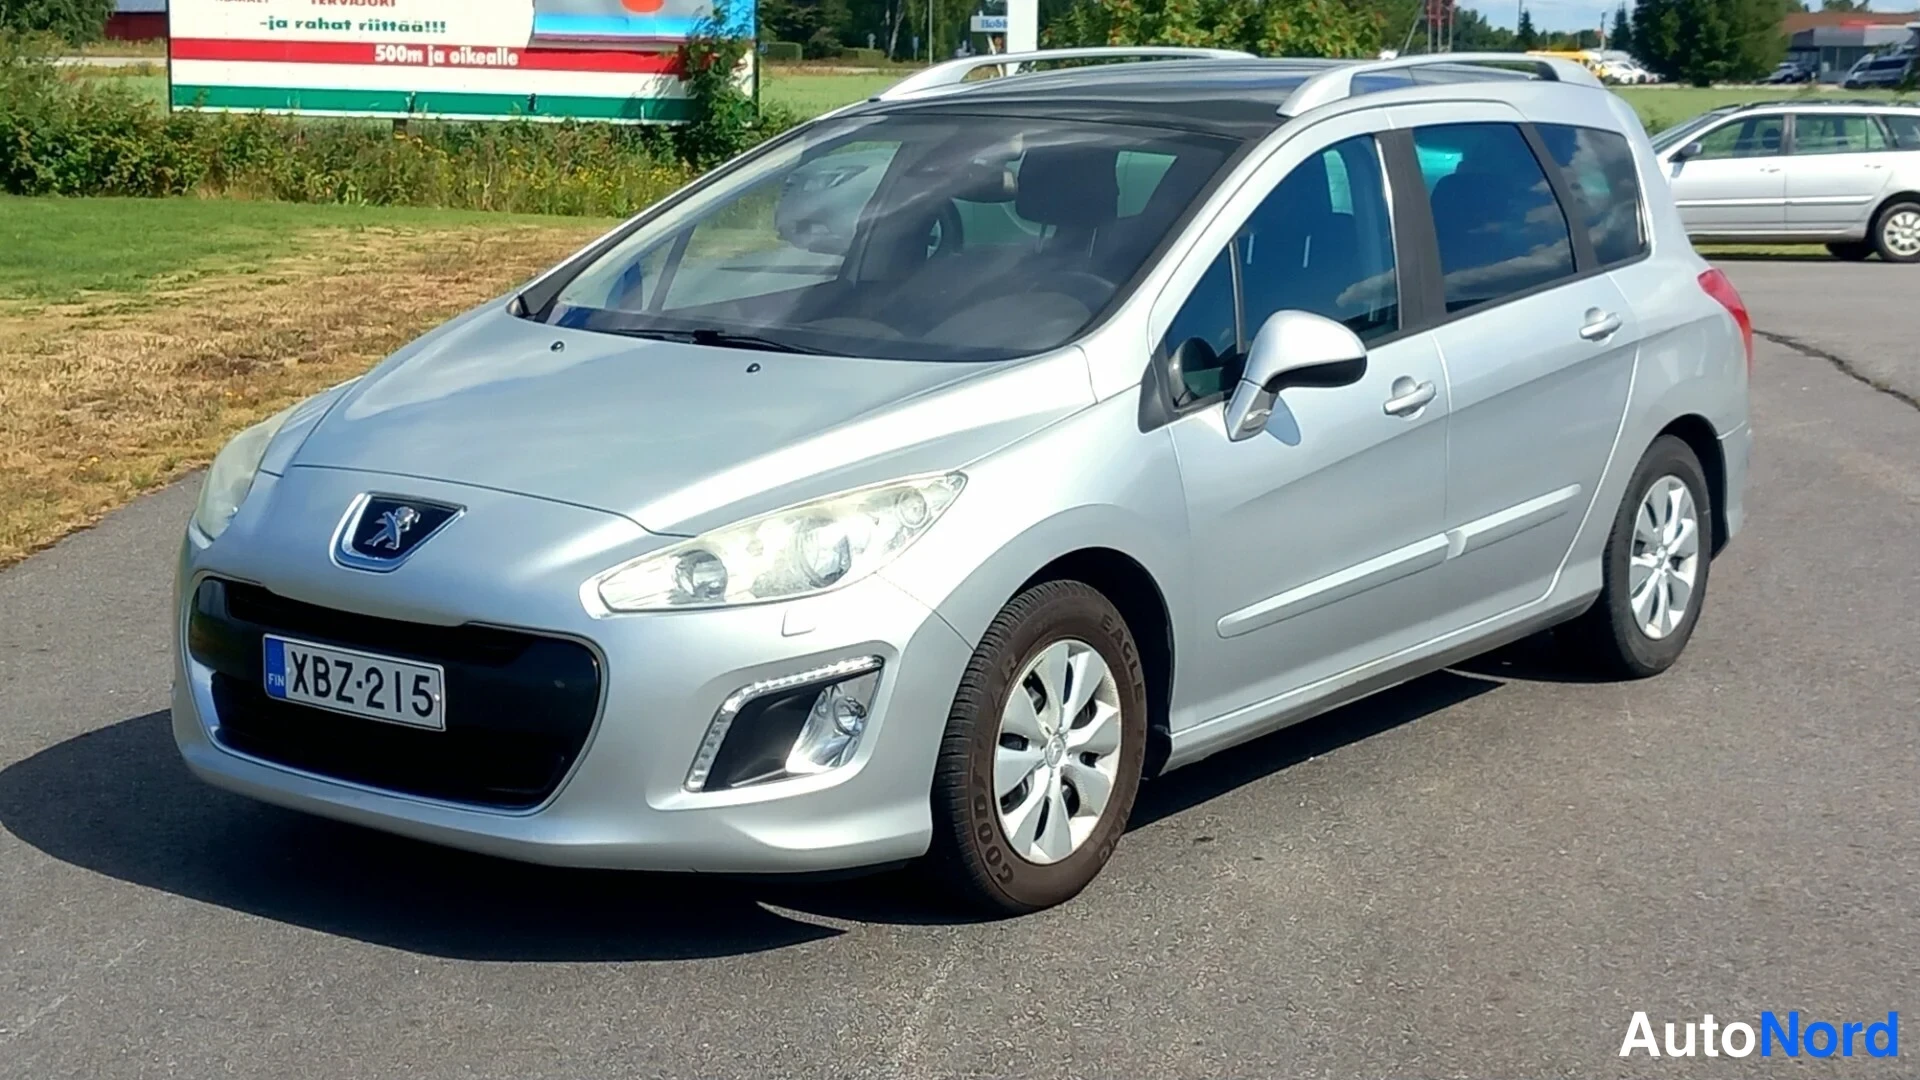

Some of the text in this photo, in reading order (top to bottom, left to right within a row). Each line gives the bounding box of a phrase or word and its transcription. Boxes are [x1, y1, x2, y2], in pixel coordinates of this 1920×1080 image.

[259, 15, 288, 30] -ja
[295, 17, 352, 31] rahat
[375, 44, 519, 66] 500m ja oikealle
[267, 672, 285, 687] FIN
[291, 651, 434, 718] XBZ-215
